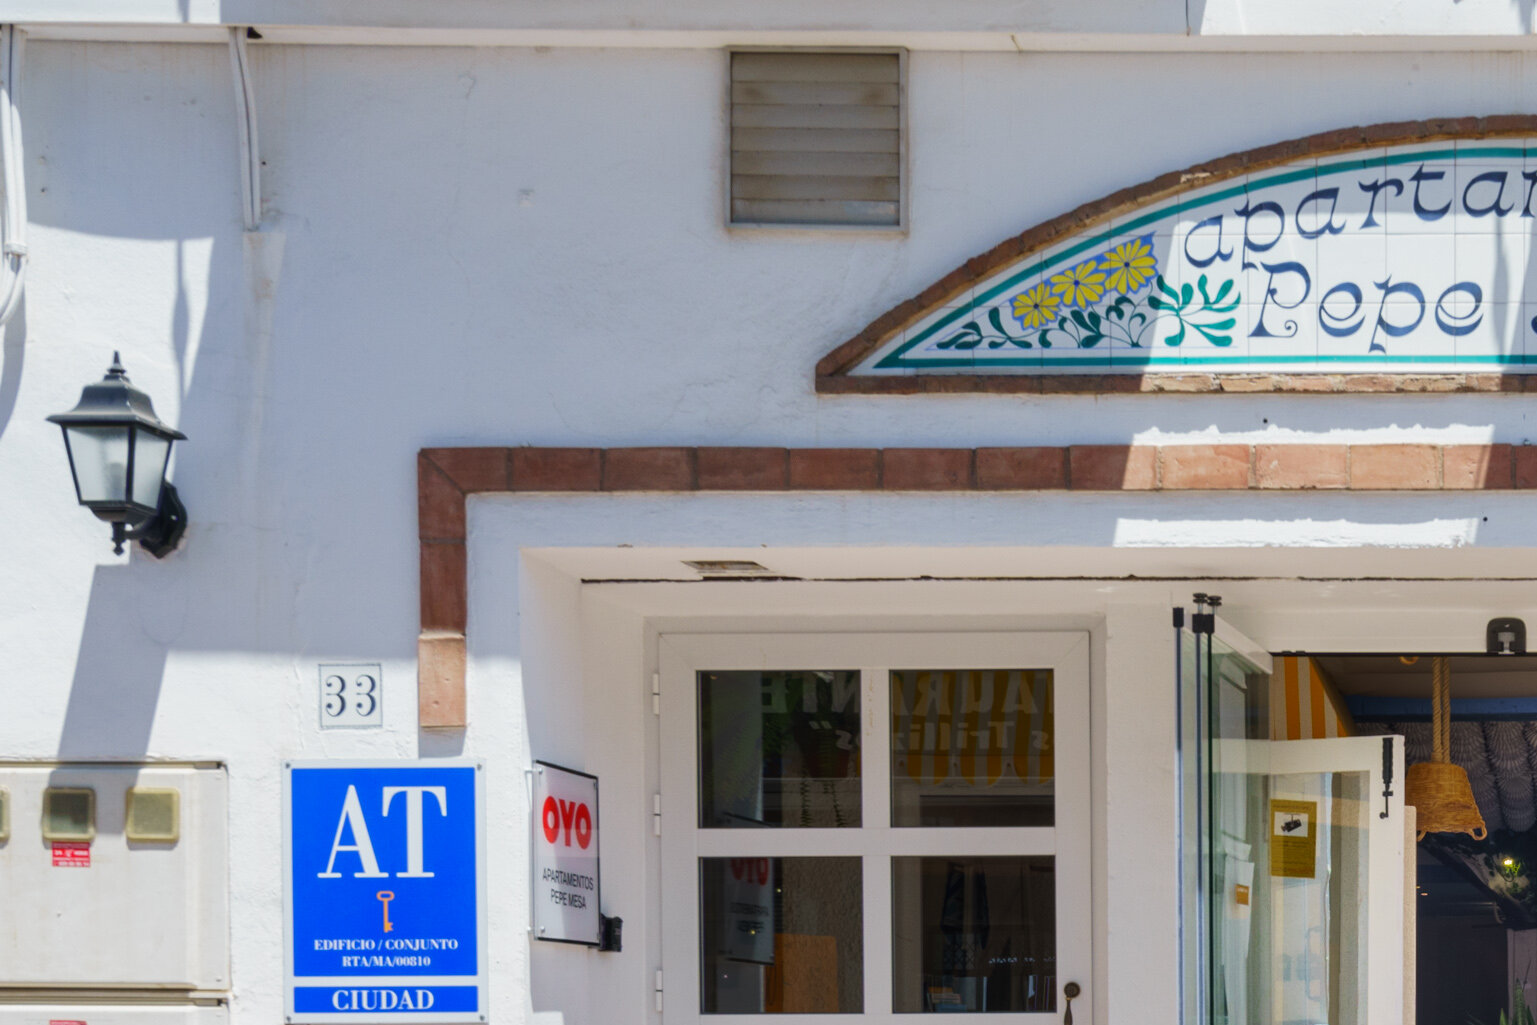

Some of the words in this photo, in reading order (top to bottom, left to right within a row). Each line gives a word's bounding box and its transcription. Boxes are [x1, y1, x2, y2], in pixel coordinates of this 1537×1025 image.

[1247, 260, 1485, 354] Pepe
[325, 674, 377, 717] 33
[317, 784, 447, 878] AT
[542, 796, 592, 850] OYO
[542, 867, 594, 891] APARTAMENTOS
[551, 890, 567, 905] PEPE
[568, 893, 587, 910] MESA
[314, 939, 376, 951] EDIFICIO
[377, 939, 383, 950] /
[385, 938, 459, 951] CONJUNTO
[342, 955, 431, 968] RTA/MA/00810
[332, 989, 435, 1011] CIUDAD
